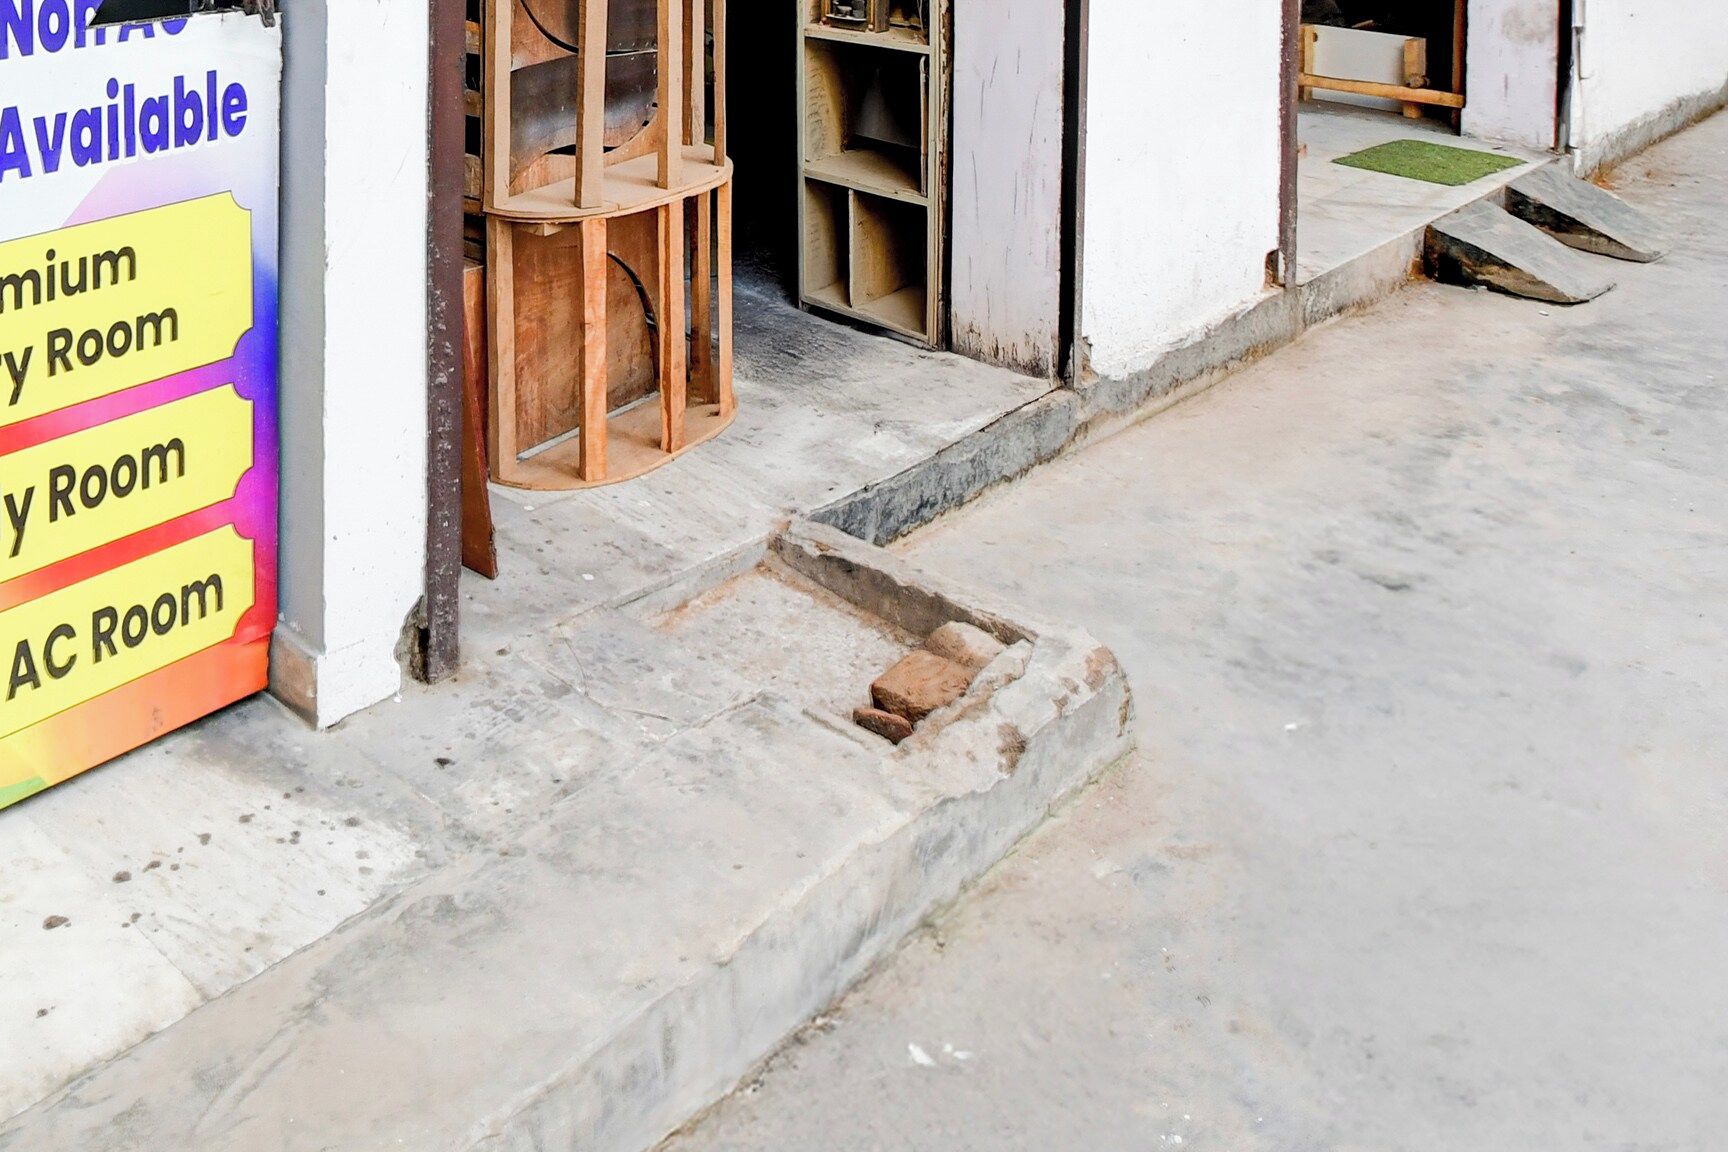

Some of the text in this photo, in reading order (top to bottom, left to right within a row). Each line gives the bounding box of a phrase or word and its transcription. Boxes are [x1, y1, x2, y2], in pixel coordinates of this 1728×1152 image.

[46, 306, 180, 378] Room
[48, 436, 187, 523] Room
[5, 622, 79, 702] AC
[91, 570, 225, 664] Room
